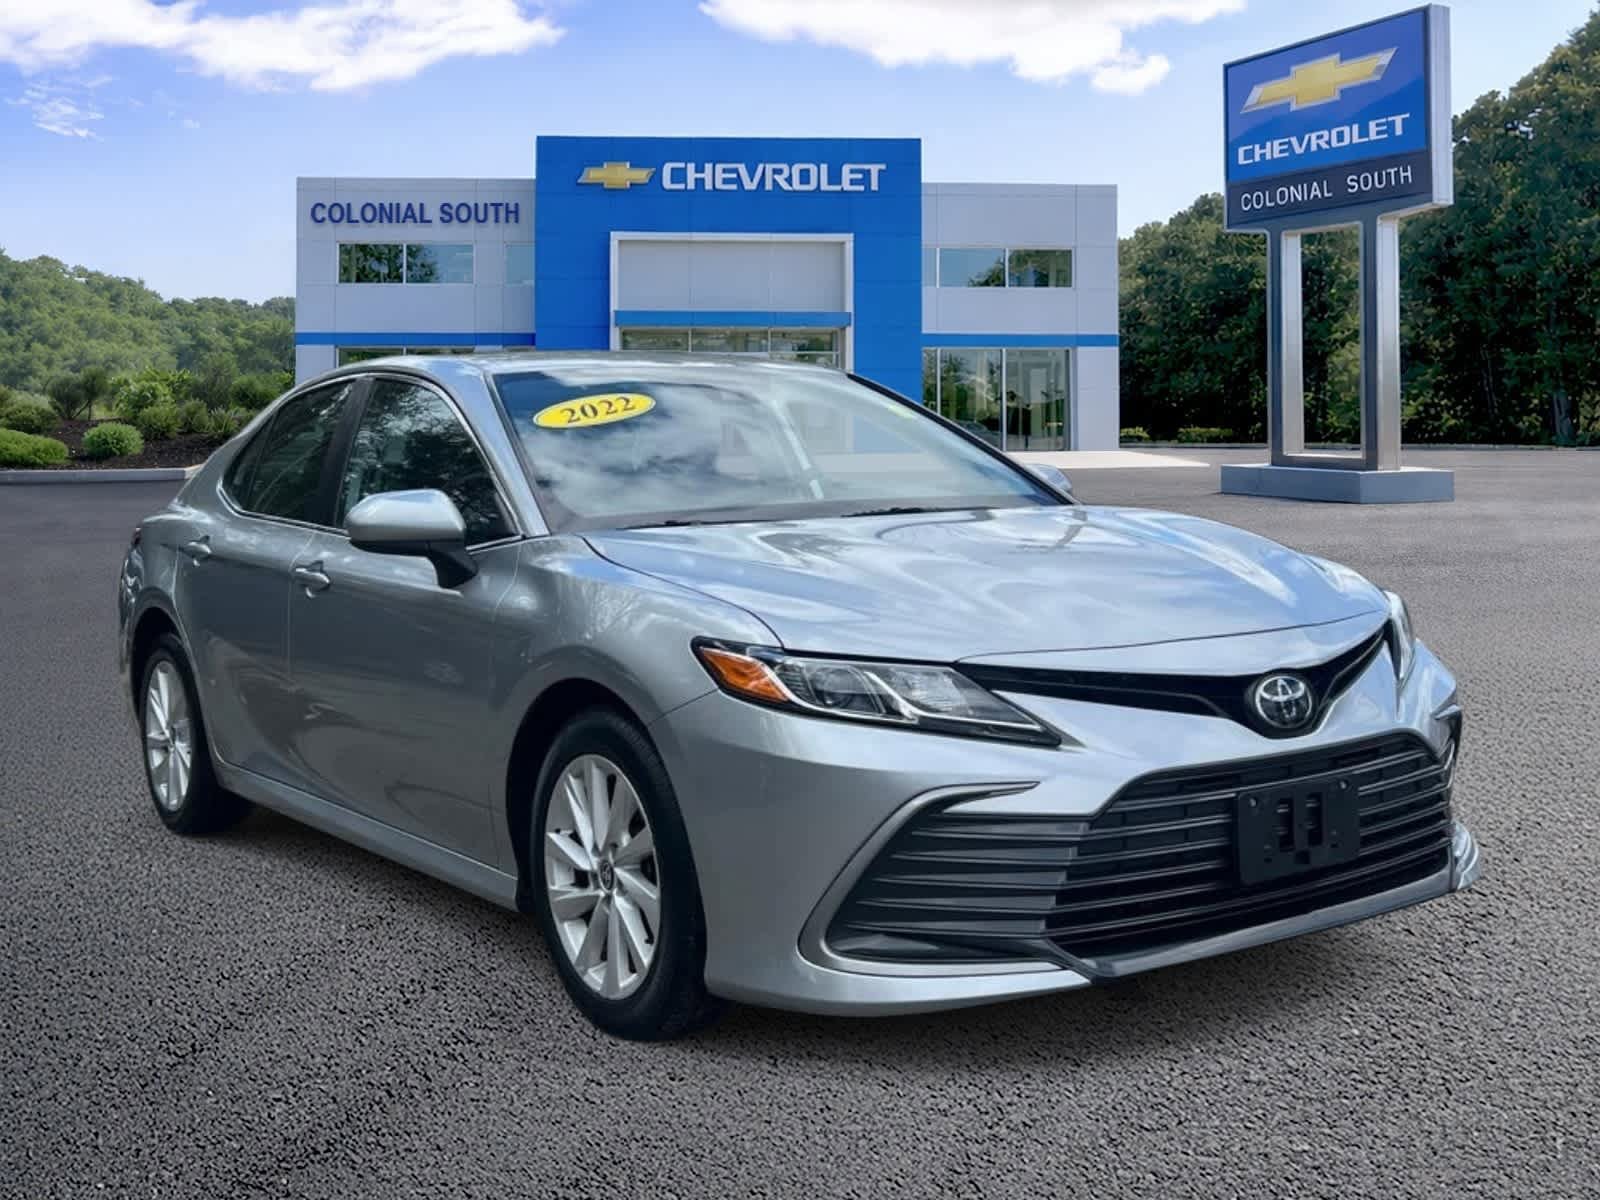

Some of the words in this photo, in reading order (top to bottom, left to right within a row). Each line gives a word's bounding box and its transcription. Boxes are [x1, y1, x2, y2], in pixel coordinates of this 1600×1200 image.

[1237, 112, 1410, 166] CHEVROLET
[661, 161, 887, 193] CHEVROLET
[1240, 180, 1333, 212] COLONIAL
[1346, 164, 1413, 194] SOUTH
[310, 201, 433, 226] COLONIAL
[438, 200, 521, 225] SOUTH
[560, 395, 636, 424] 2022
